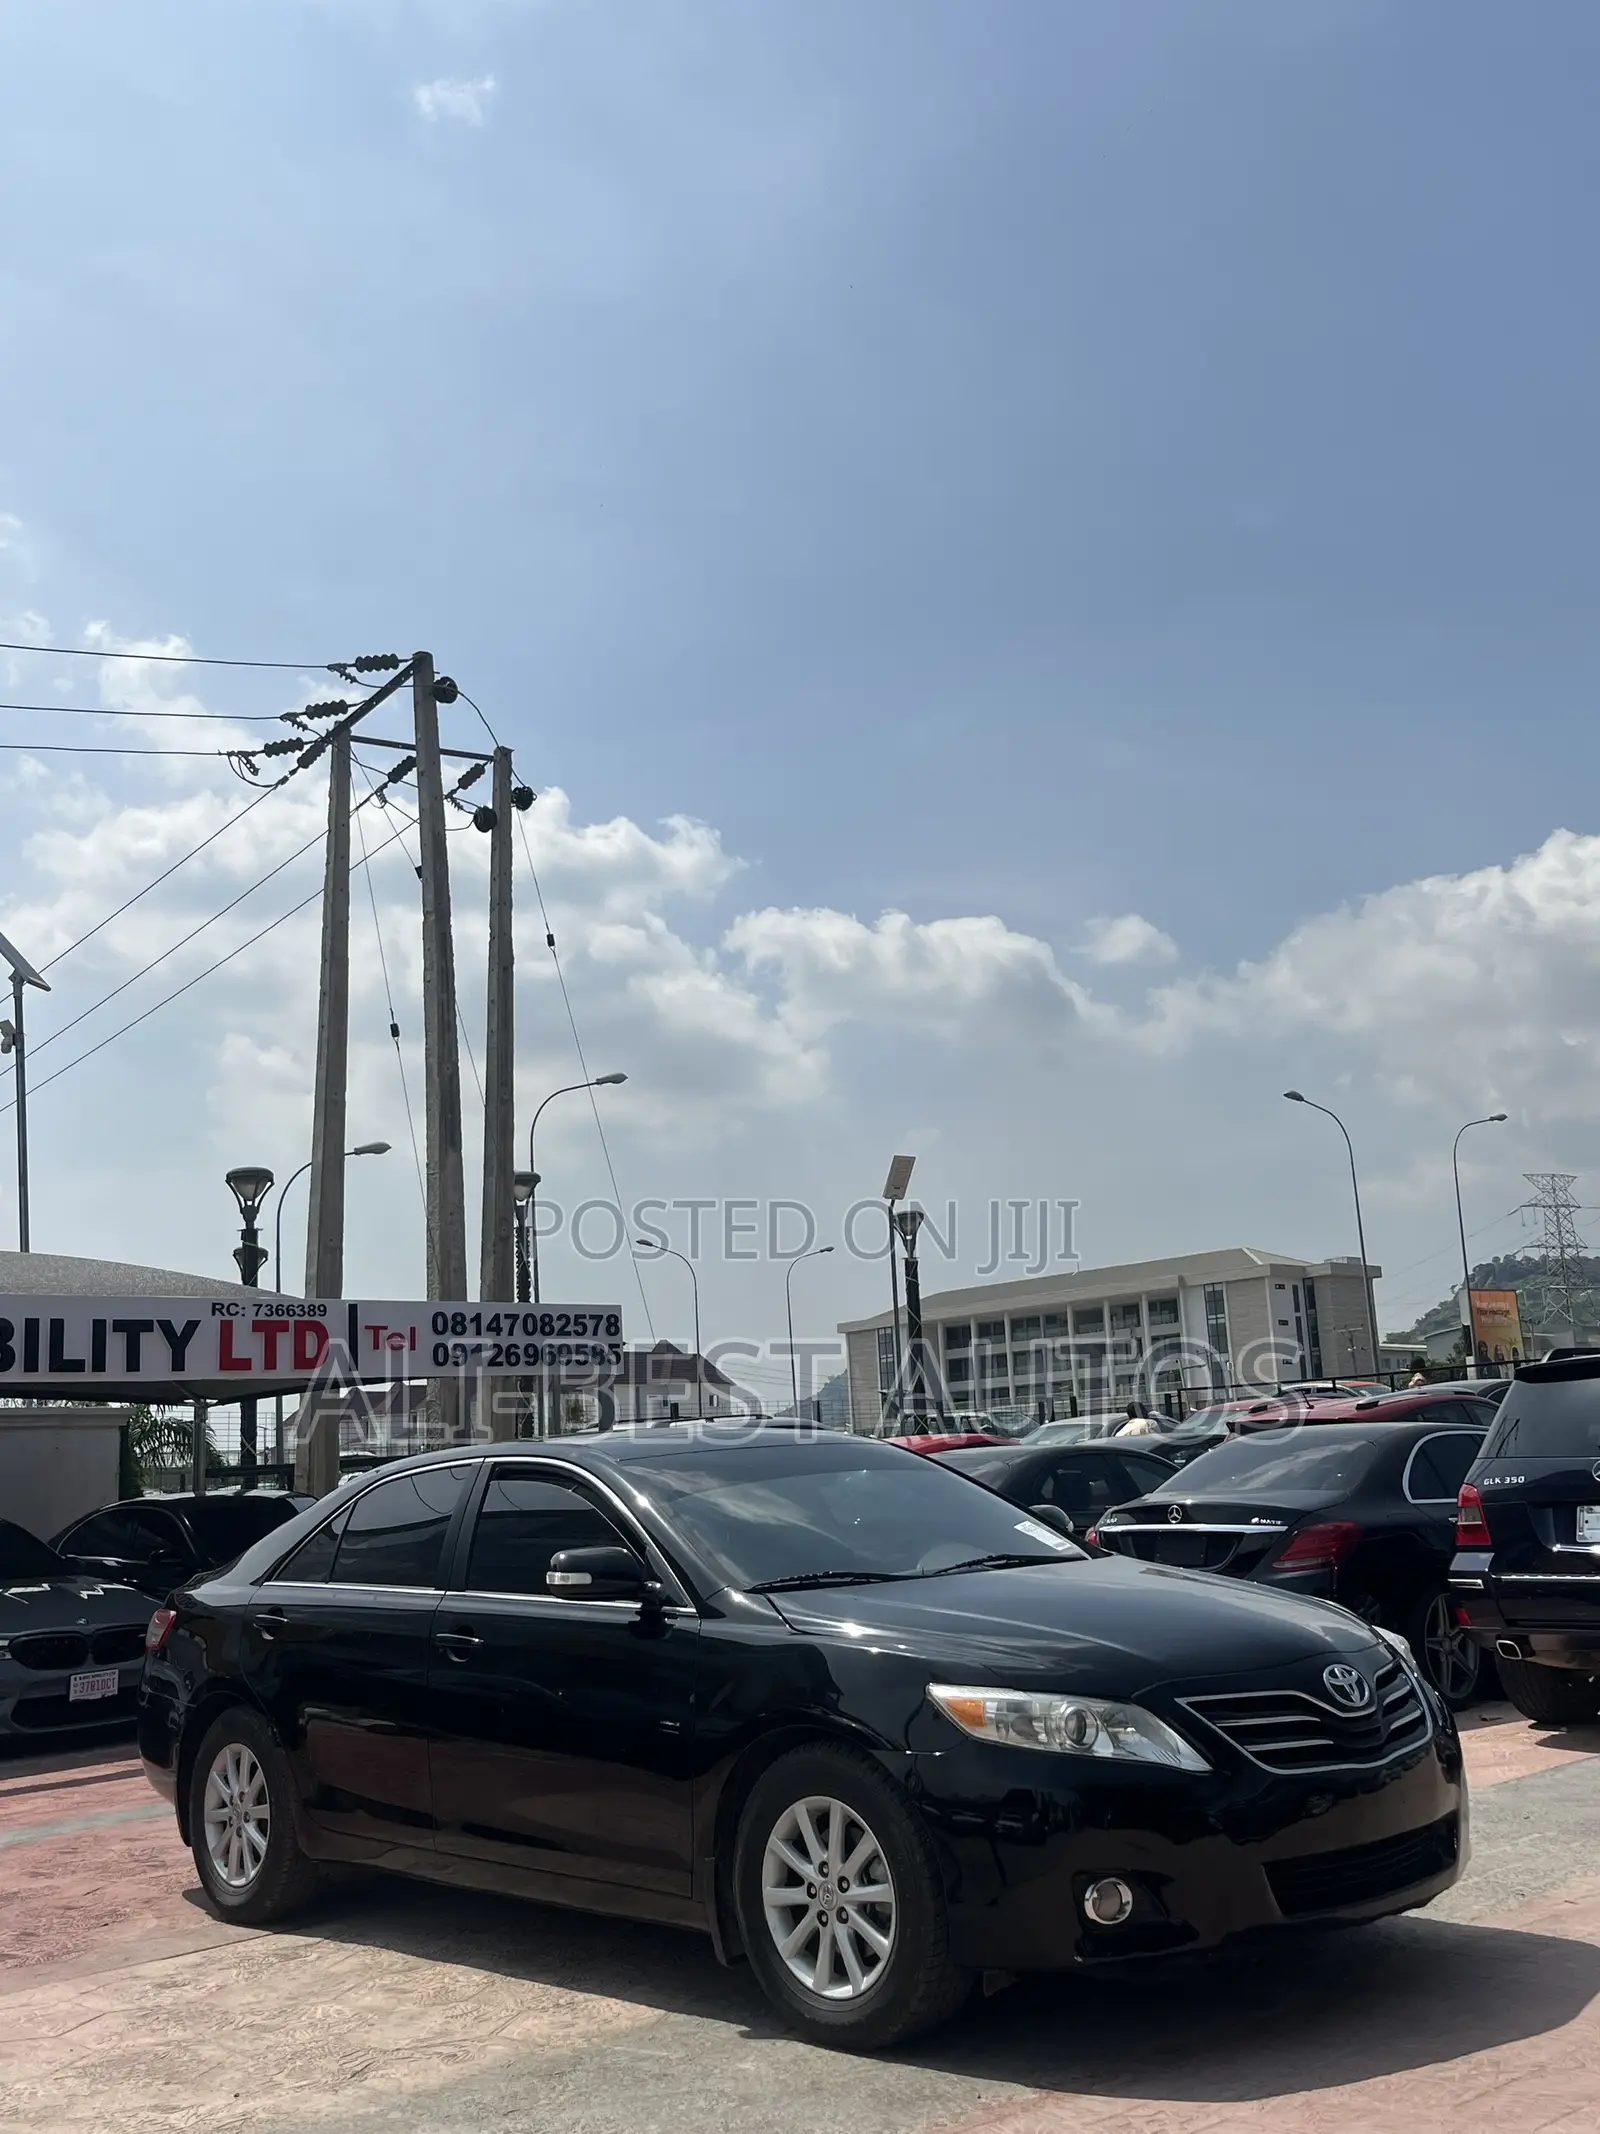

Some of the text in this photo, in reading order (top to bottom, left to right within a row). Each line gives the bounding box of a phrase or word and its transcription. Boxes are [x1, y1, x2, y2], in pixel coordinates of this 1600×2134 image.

[211, 1302, 328, 1317] RC: 7366389
[431, 1311, 621, 1336] 08147082578
[219, 1319, 330, 1372] LTD
[364, 1325, 417, 1351] Tel
[432, 1341, 622, 1367] 09126969585
[1483, 1475, 1526, 1486] GLK 350
